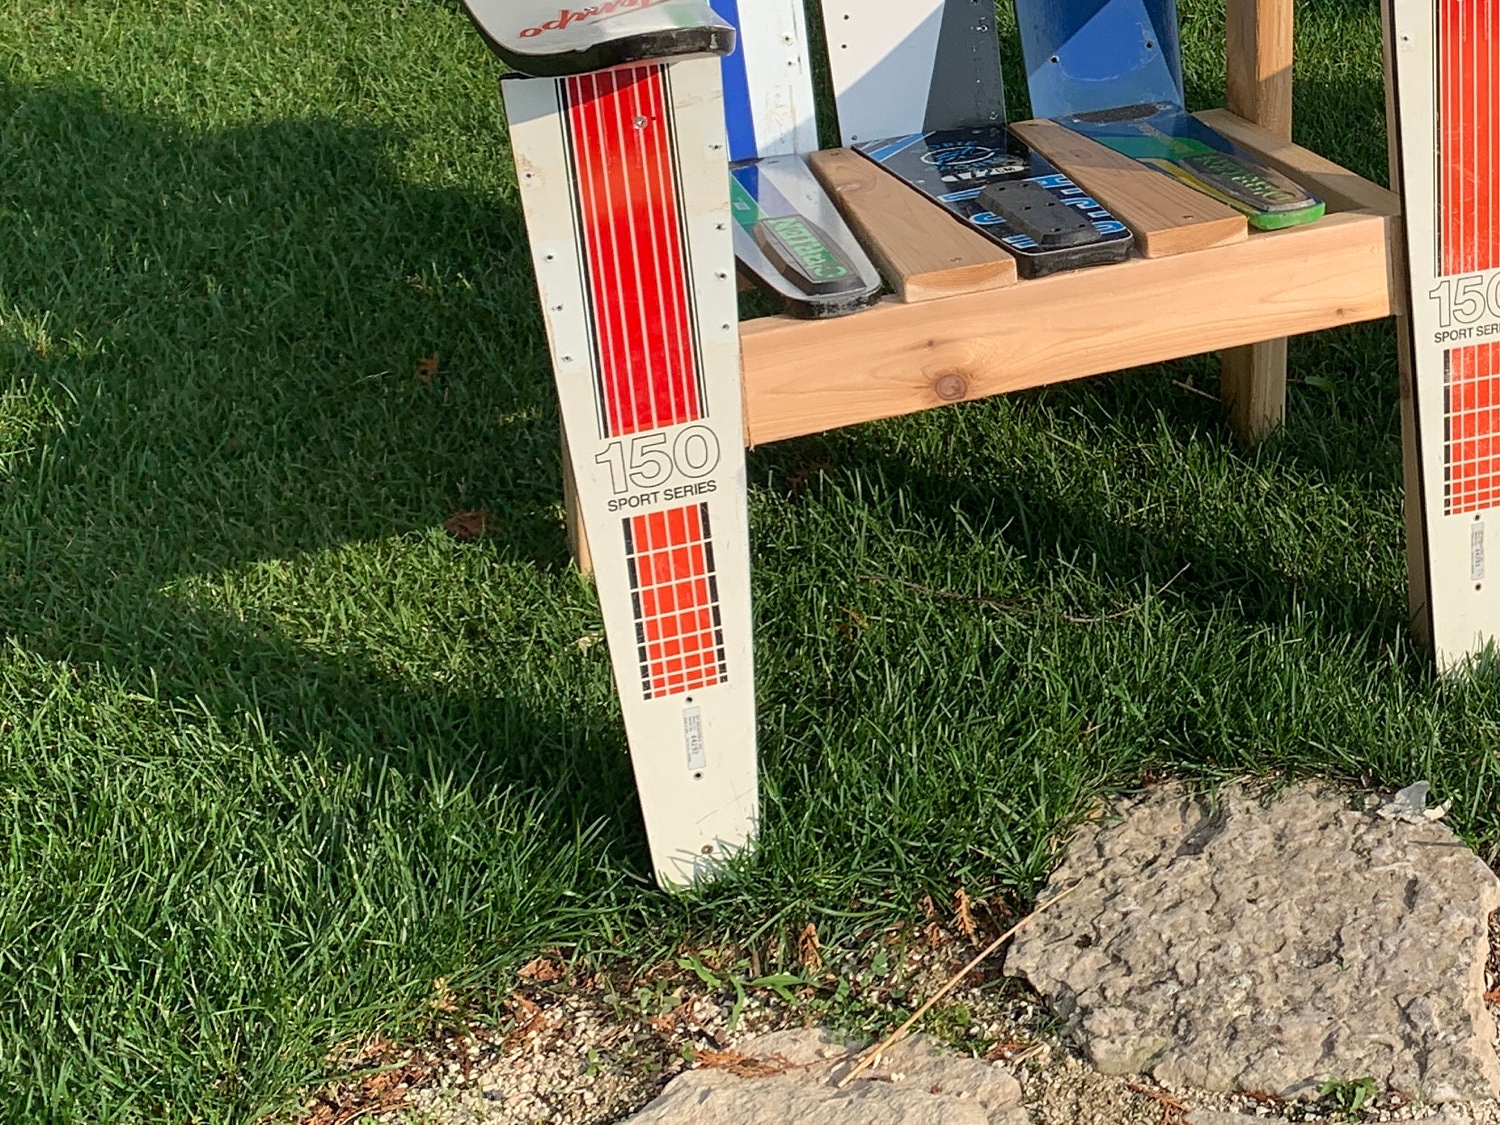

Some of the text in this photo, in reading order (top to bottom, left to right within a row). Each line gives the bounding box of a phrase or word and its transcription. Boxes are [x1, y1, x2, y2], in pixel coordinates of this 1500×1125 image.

[1434, 326, 1474, 344] SPORT
[596, 425, 720, 495] 150
[607, 480, 717, 513] SPORT SERIES
